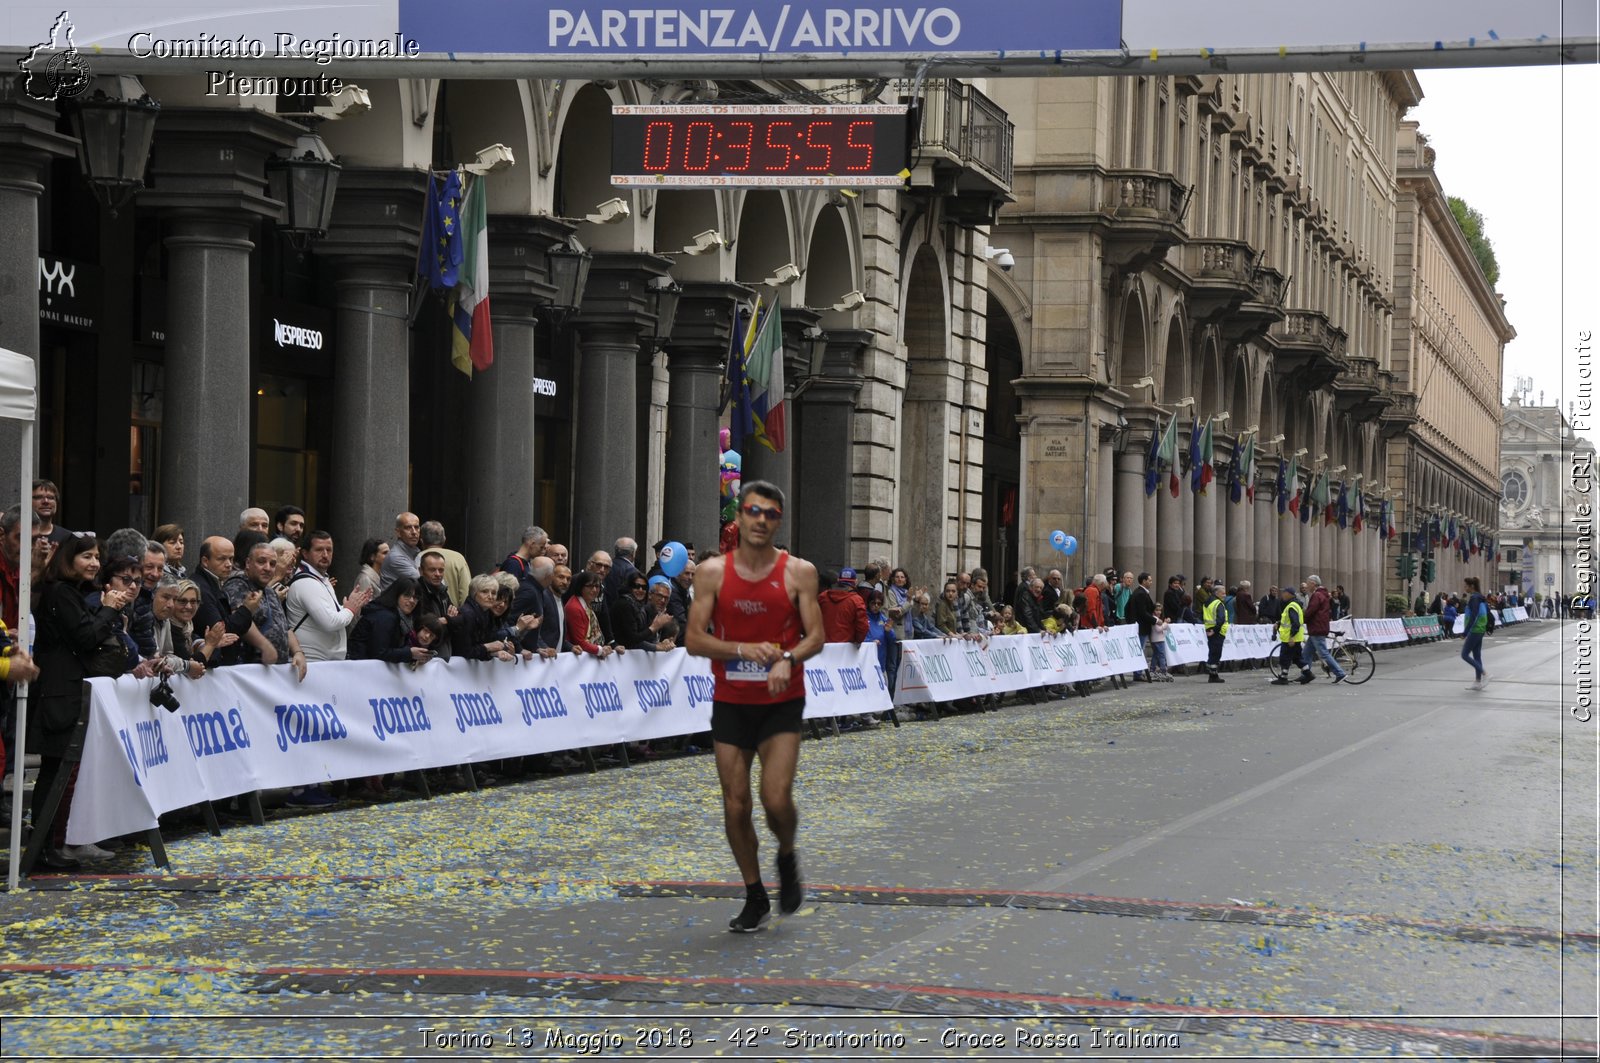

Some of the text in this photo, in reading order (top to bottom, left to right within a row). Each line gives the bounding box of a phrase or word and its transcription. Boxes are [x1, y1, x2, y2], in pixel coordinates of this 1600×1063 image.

[548, 5, 962, 51] PARTENZA/ARRIVO
[634, 106, 660, 114] TIMING
[661, 106, 678, 114] DATA
[680, 106, 709, 114] SERVICE
[732, 106, 758, 114] TIMING
[760, 106, 776, 114] DATA
[778, 106, 807, 114] SERVICE
[831, 106, 856, 114] TIMING
[858, 106, 874, 114] DATA
[876, 106, 907, 114] SERVICE
[643, 121, 873, 172] 00:35:55
[385, 204, 398, 216] 17
[64, 314, 93, 327] MAKEUP
[274, 318, 322, 349] NESPRESSO
[274, 703, 347, 752] Joma
[368, 695, 431, 741] Joma
[450, 692, 503, 734] Joma
[515, 686, 568, 726] Joma
[579, 681, 623, 719] Joma
[634, 677, 672, 713] Joma
